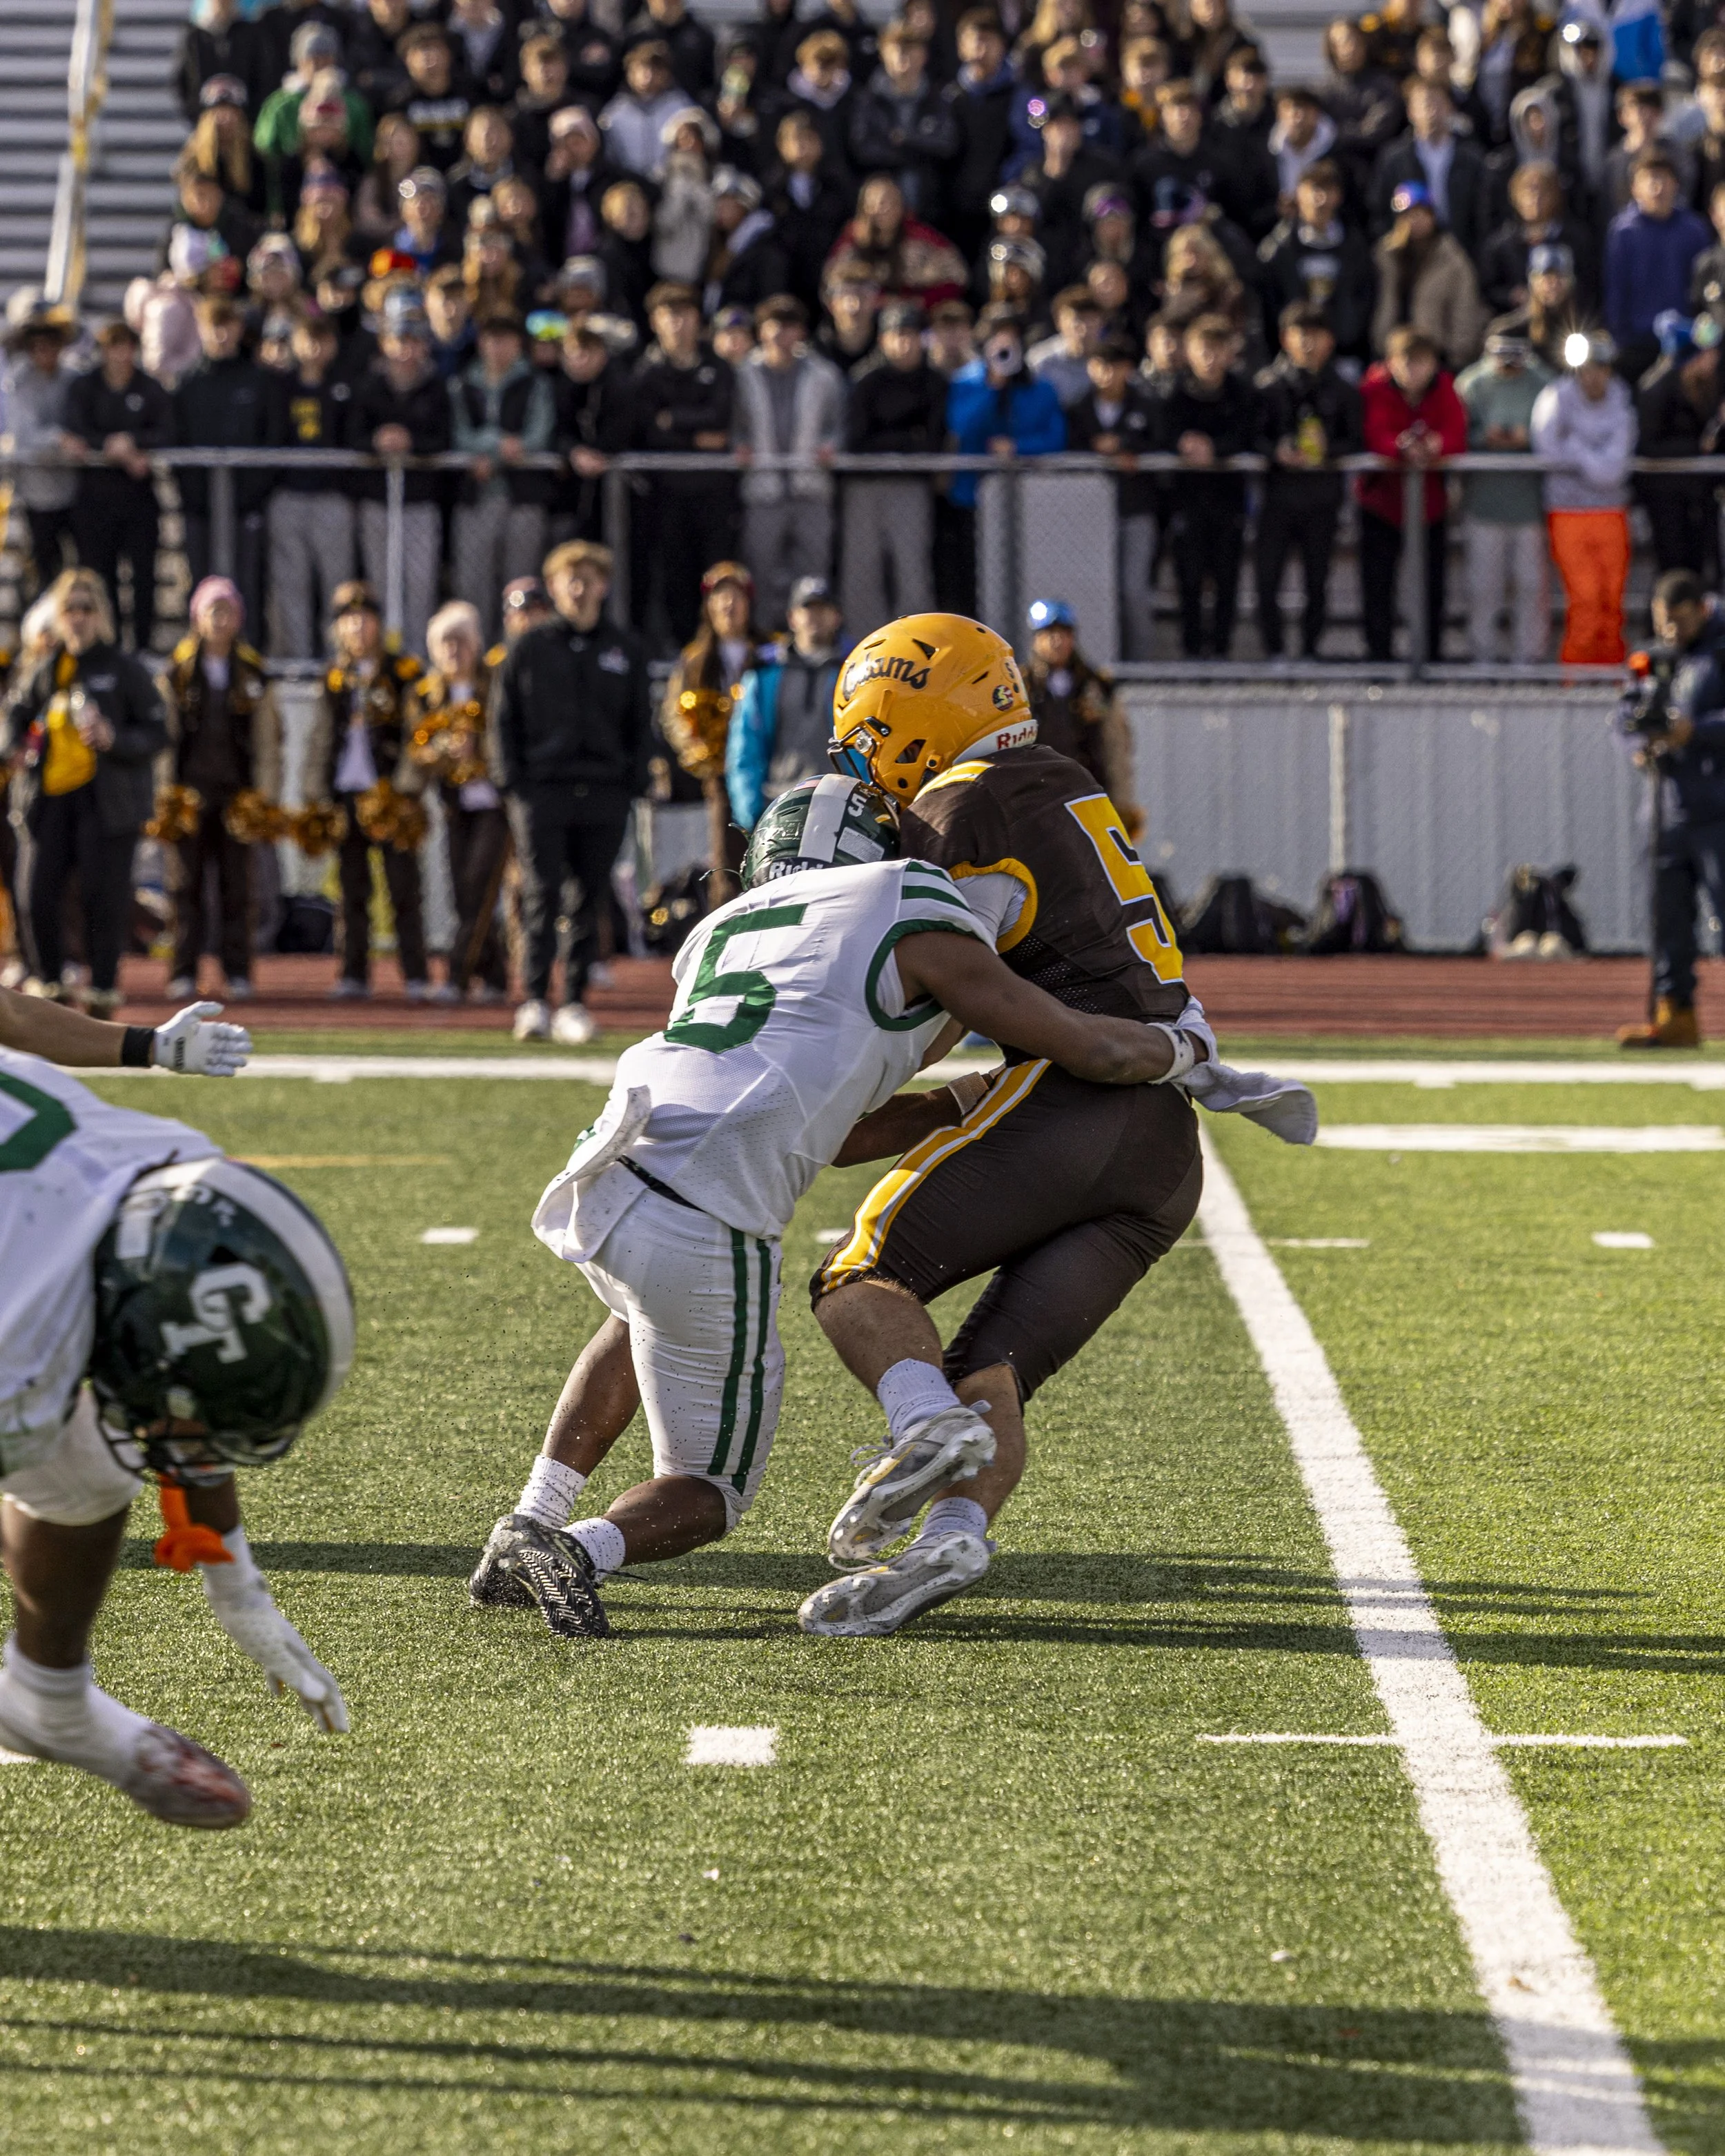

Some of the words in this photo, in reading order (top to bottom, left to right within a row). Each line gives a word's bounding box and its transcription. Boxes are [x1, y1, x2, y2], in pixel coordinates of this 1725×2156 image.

[842, 652, 931, 702] ams
[849, 793, 867, 817] 5
[769, 861, 824, 880] Rid
[1064, 793, 1185, 985] 5
[664, 903, 808, 1054] 5
